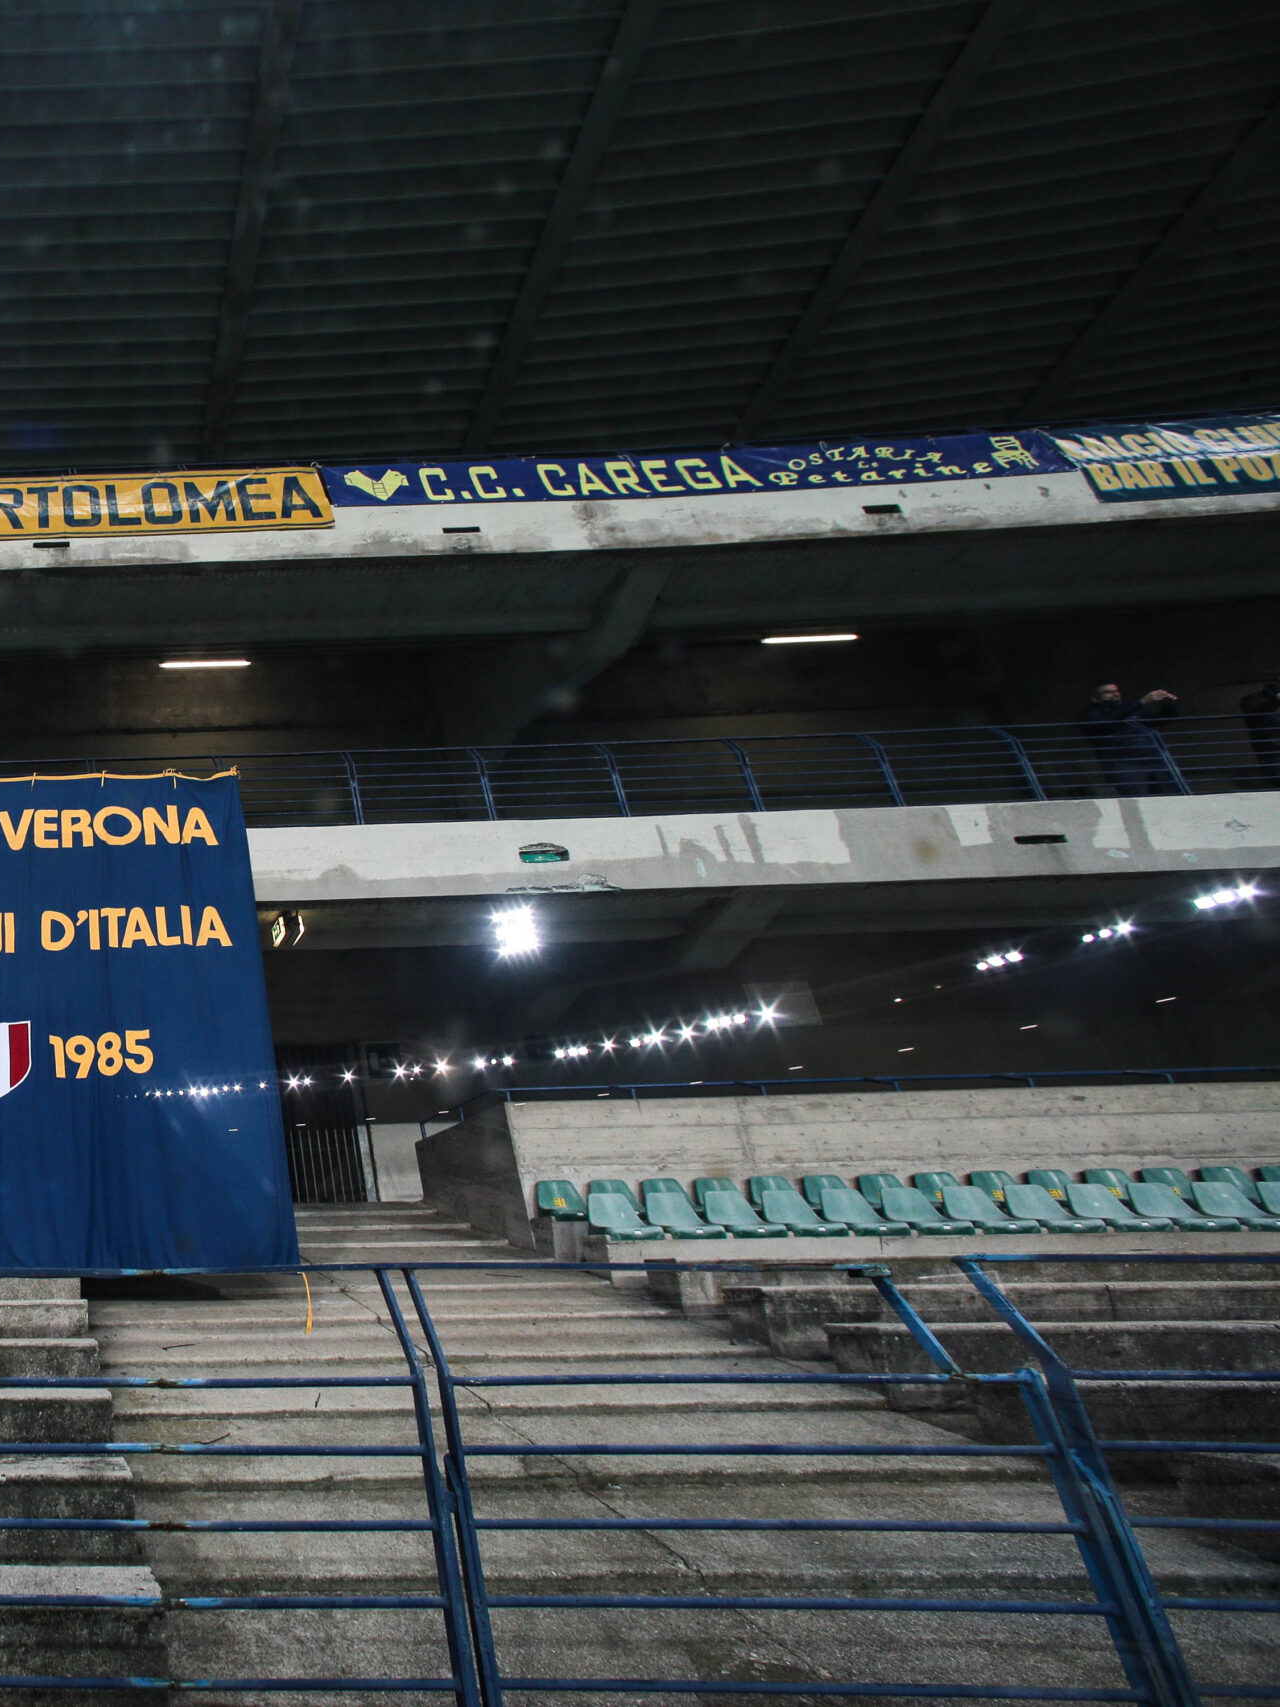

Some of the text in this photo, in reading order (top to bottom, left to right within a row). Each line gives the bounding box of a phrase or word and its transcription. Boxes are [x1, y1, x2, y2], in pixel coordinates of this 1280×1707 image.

[536, 456, 764, 496] CAREGA
[768, 461, 993, 486] Petarine
[787, 446, 943, 470] OSTARIA
[1083, 459, 1176, 490] BAR
[1171, 456, 1217, 486] IL
[41, 905, 233, 951] D'ITALIA
[49, 1029, 154, 1079] 1985
